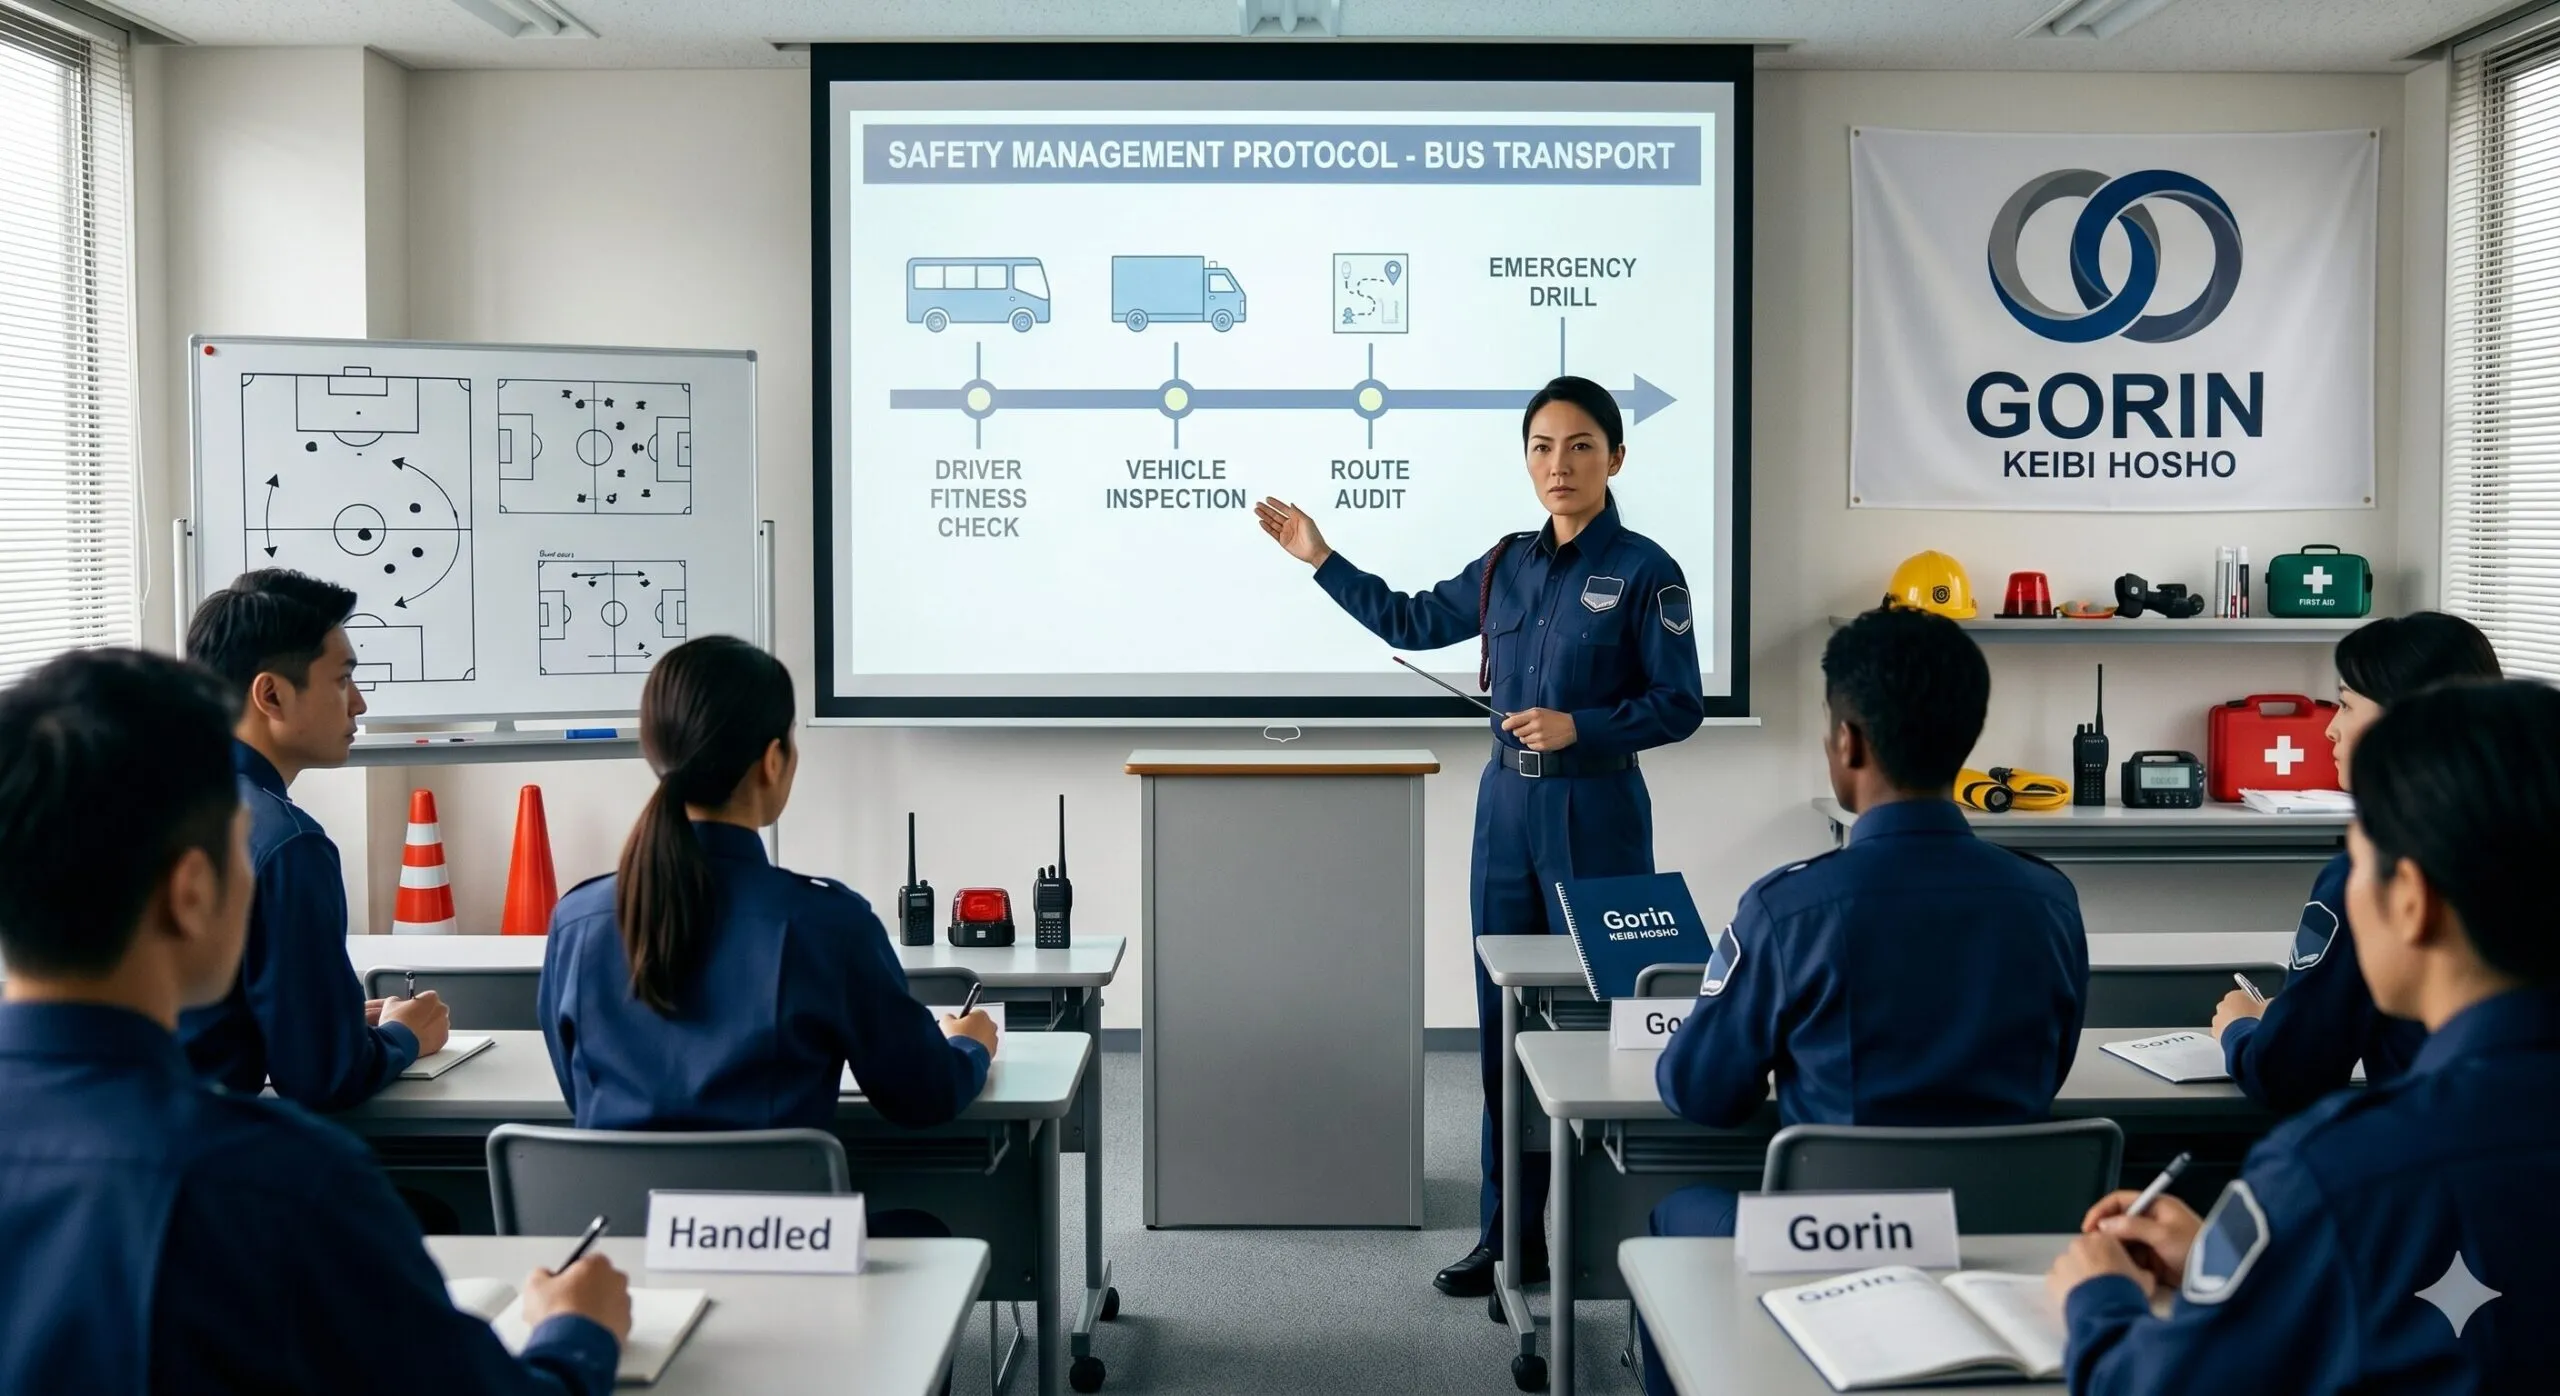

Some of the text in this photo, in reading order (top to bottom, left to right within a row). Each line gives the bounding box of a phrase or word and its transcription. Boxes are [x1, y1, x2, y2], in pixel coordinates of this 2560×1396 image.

[888, 140, 1004, 169] SAFETY
[1012, 140, 1225, 169] MANAGEMENT
[1233, 140, 1399, 169] PROTOCOL
[1425, 140, 1485, 169] BUS
[1492, 141, 1676, 170] TRANSPORT
[1489, 256, 1637, 278] EMERGENCY
[1530, 286, 1597, 307] DRILL
[1966, 370, 2264, 440] GORIN
[935, 459, 1022, 480] DRIVER
[1125, 459, 1226, 480] VEHICLE
[1331, 459, 1410, 480] ROUTE
[2003, 450, 2236, 479] KEIBI HOSHO
[930, 488, 1027, 509] FITNESS
[1106, 488, 1247, 509] INSPECTION
[1334, 488, 1406, 509] AUDIT
[938, 516, 1020, 538] CHECK
[2299, 598, 2335, 606] FIRST AID
[1603, 907, 1675, 929] Gorin
[1609, 928, 1679, 941] KEIBI HOSHO
[2131, 1034, 2195, 1049] Gorin
[669, 1216, 832, 1251] Handled
[1789, 1213, 1913, 1252] Gorin
